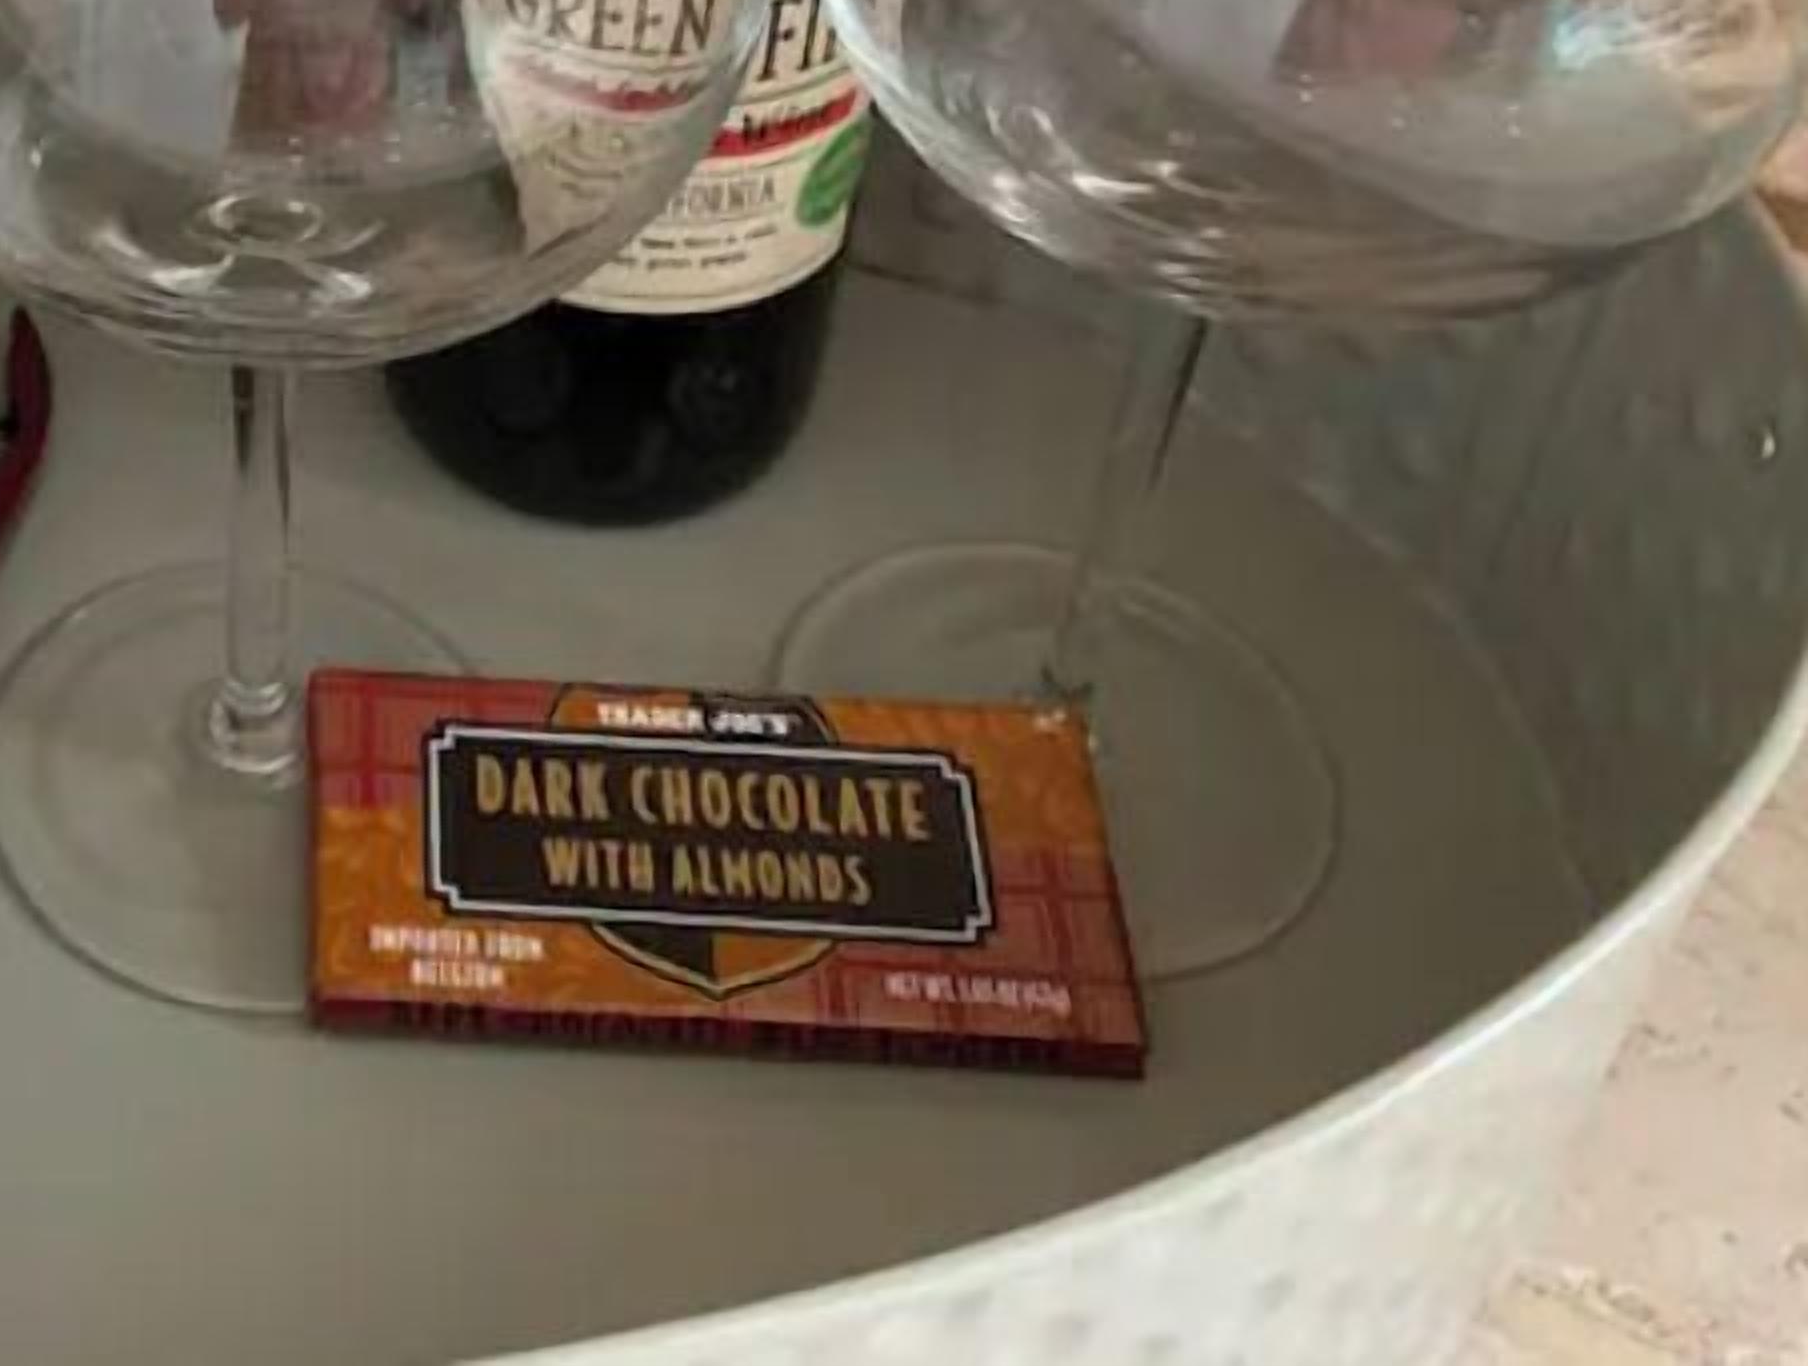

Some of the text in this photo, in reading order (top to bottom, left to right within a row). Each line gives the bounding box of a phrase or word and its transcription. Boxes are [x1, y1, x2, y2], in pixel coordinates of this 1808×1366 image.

[475, 752, 933, 842] DARK CHOCOLATE
[541, 836, 874, 907] WITH ALMONDS
